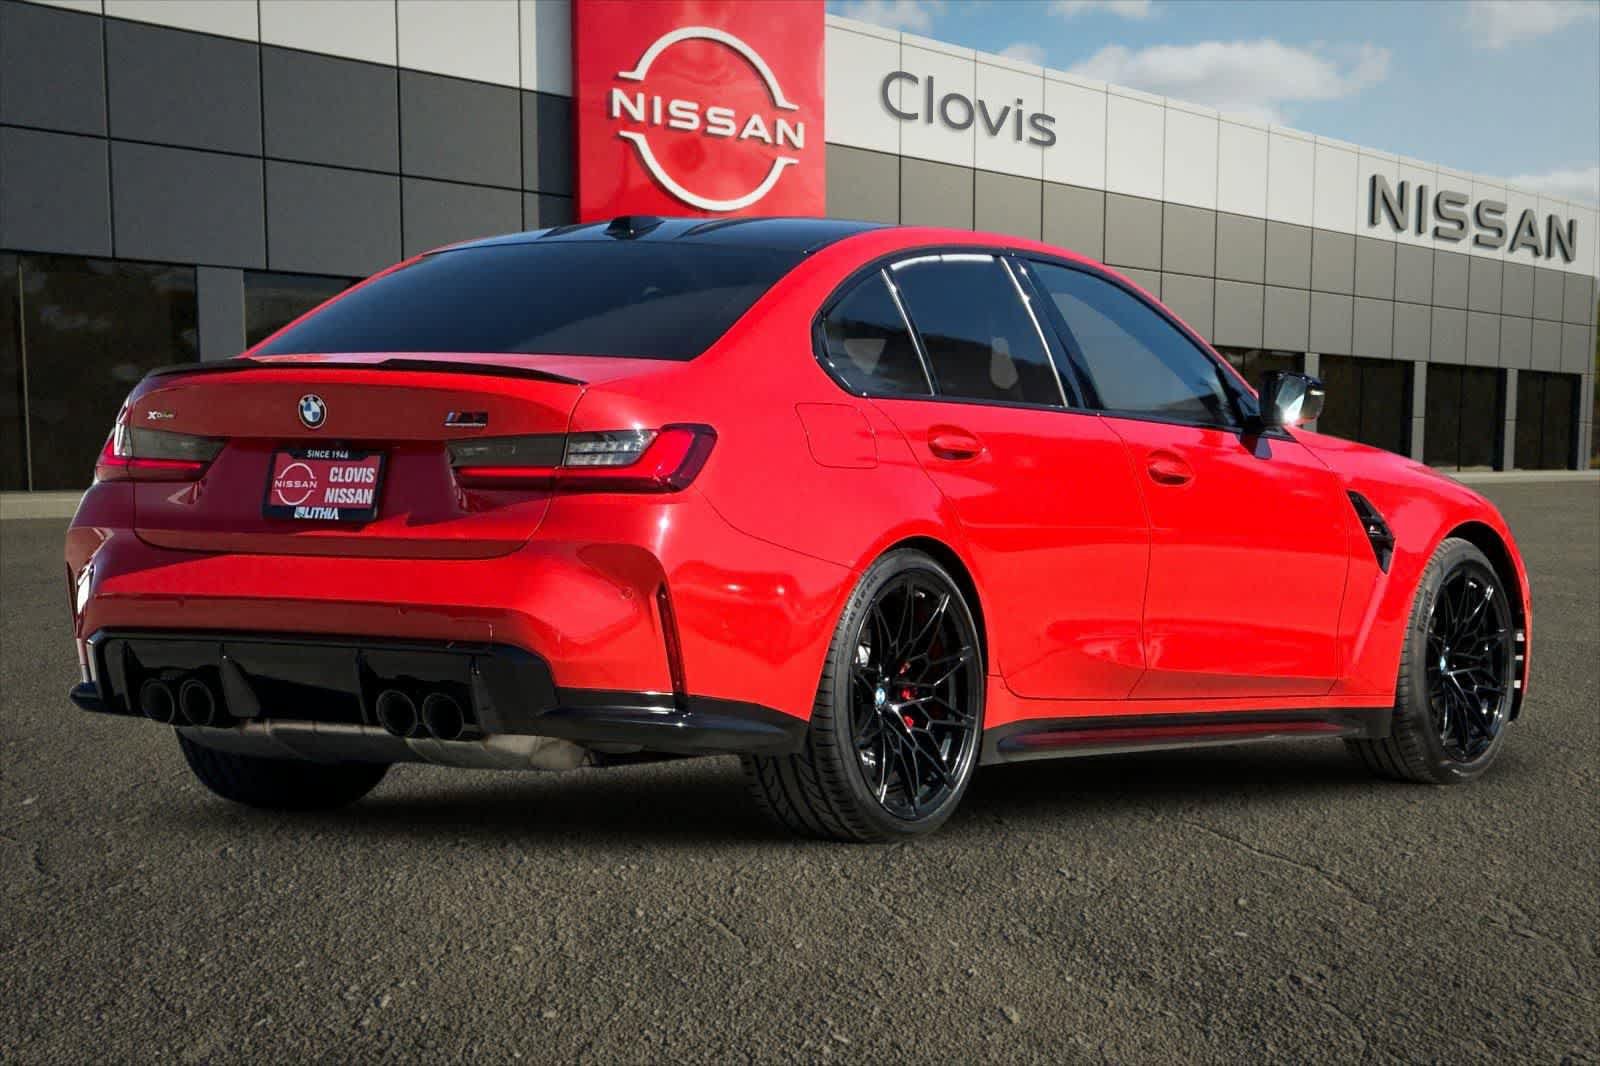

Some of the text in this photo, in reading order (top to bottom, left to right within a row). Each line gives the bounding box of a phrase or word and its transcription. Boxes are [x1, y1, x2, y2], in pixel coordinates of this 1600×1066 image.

[882, 70, 1057, 147] Clovis
[610, 87, 805, 149] NISSAN
[1368, 173, 1578, 264] NISSAN
[306, 449, 349, 460] SINCE 1946
[329, 466, 375, 483] CLOVIS
[274, 479, 318, 489] NISSAN
[324, 487, 373, 505] NISSAN
[303, 507, 339, 520] LITHIA
